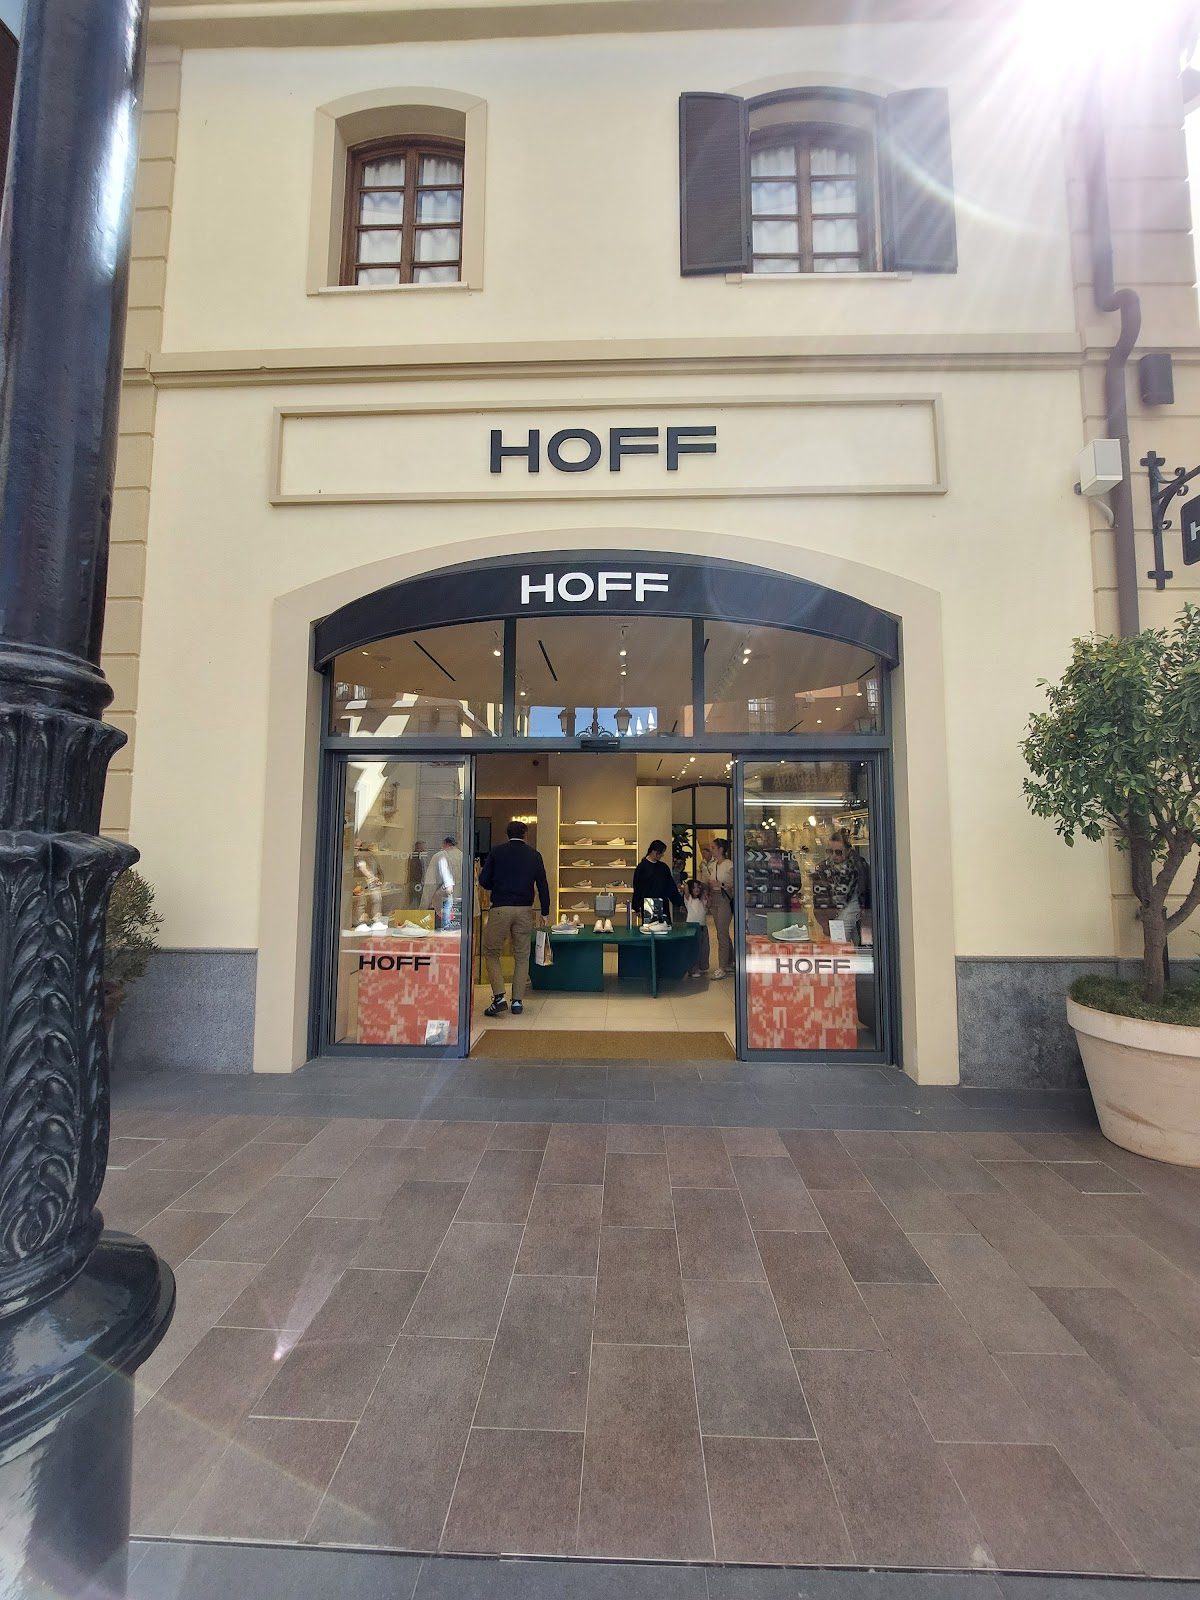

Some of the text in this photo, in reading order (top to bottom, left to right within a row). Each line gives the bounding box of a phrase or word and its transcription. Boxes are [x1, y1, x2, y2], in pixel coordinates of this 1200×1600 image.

[490, 426, 717, 473] HOFF
[521, 572, 669, 604] HOFF
[511, 816, 538, 824] HOF
[359, 955, 431, 971] HOFF
[776, 958, 851, 974] HOFF
